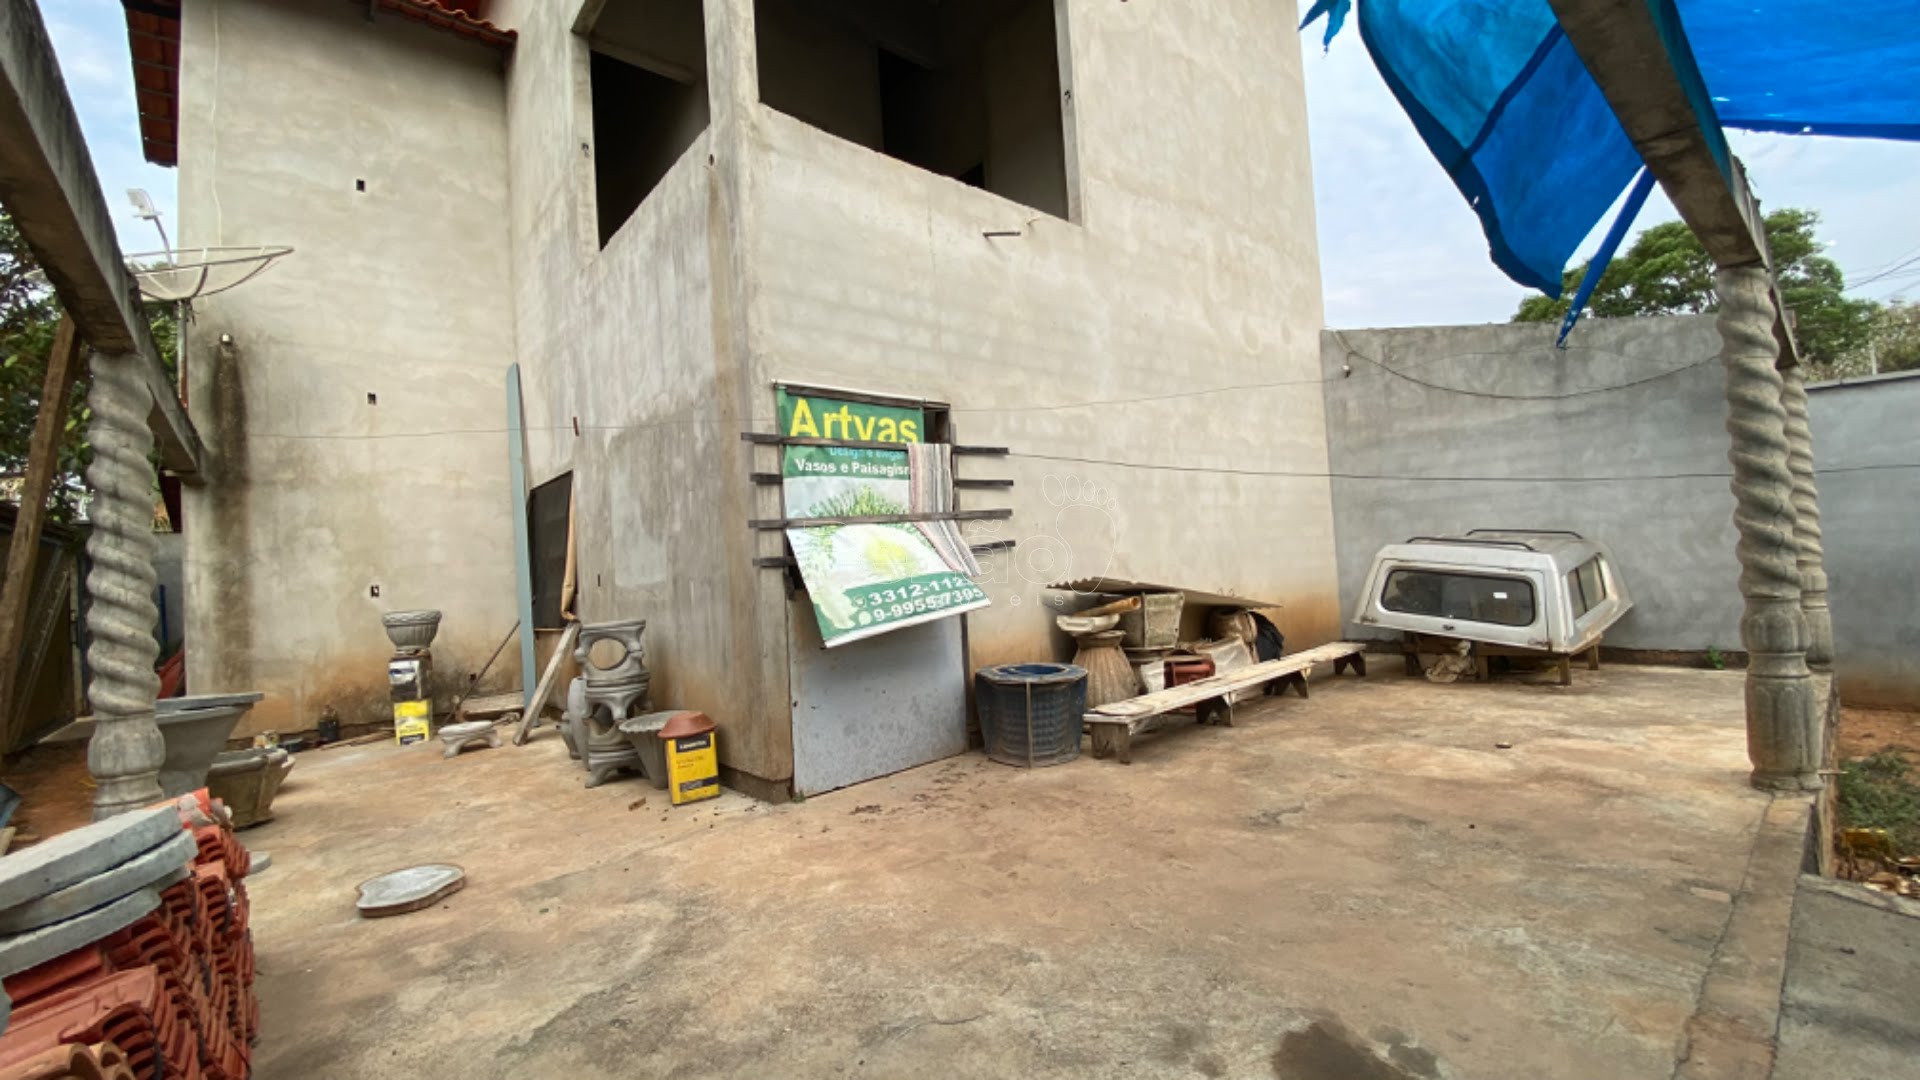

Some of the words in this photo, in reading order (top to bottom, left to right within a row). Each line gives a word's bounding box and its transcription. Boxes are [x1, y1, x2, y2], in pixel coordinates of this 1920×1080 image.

[790, 397, 918, 443] Artvas
[794, 458, 836, 473] Vasos
[840, 463, 849, 473] e
[868, 577, 967, 606] 3312-112
